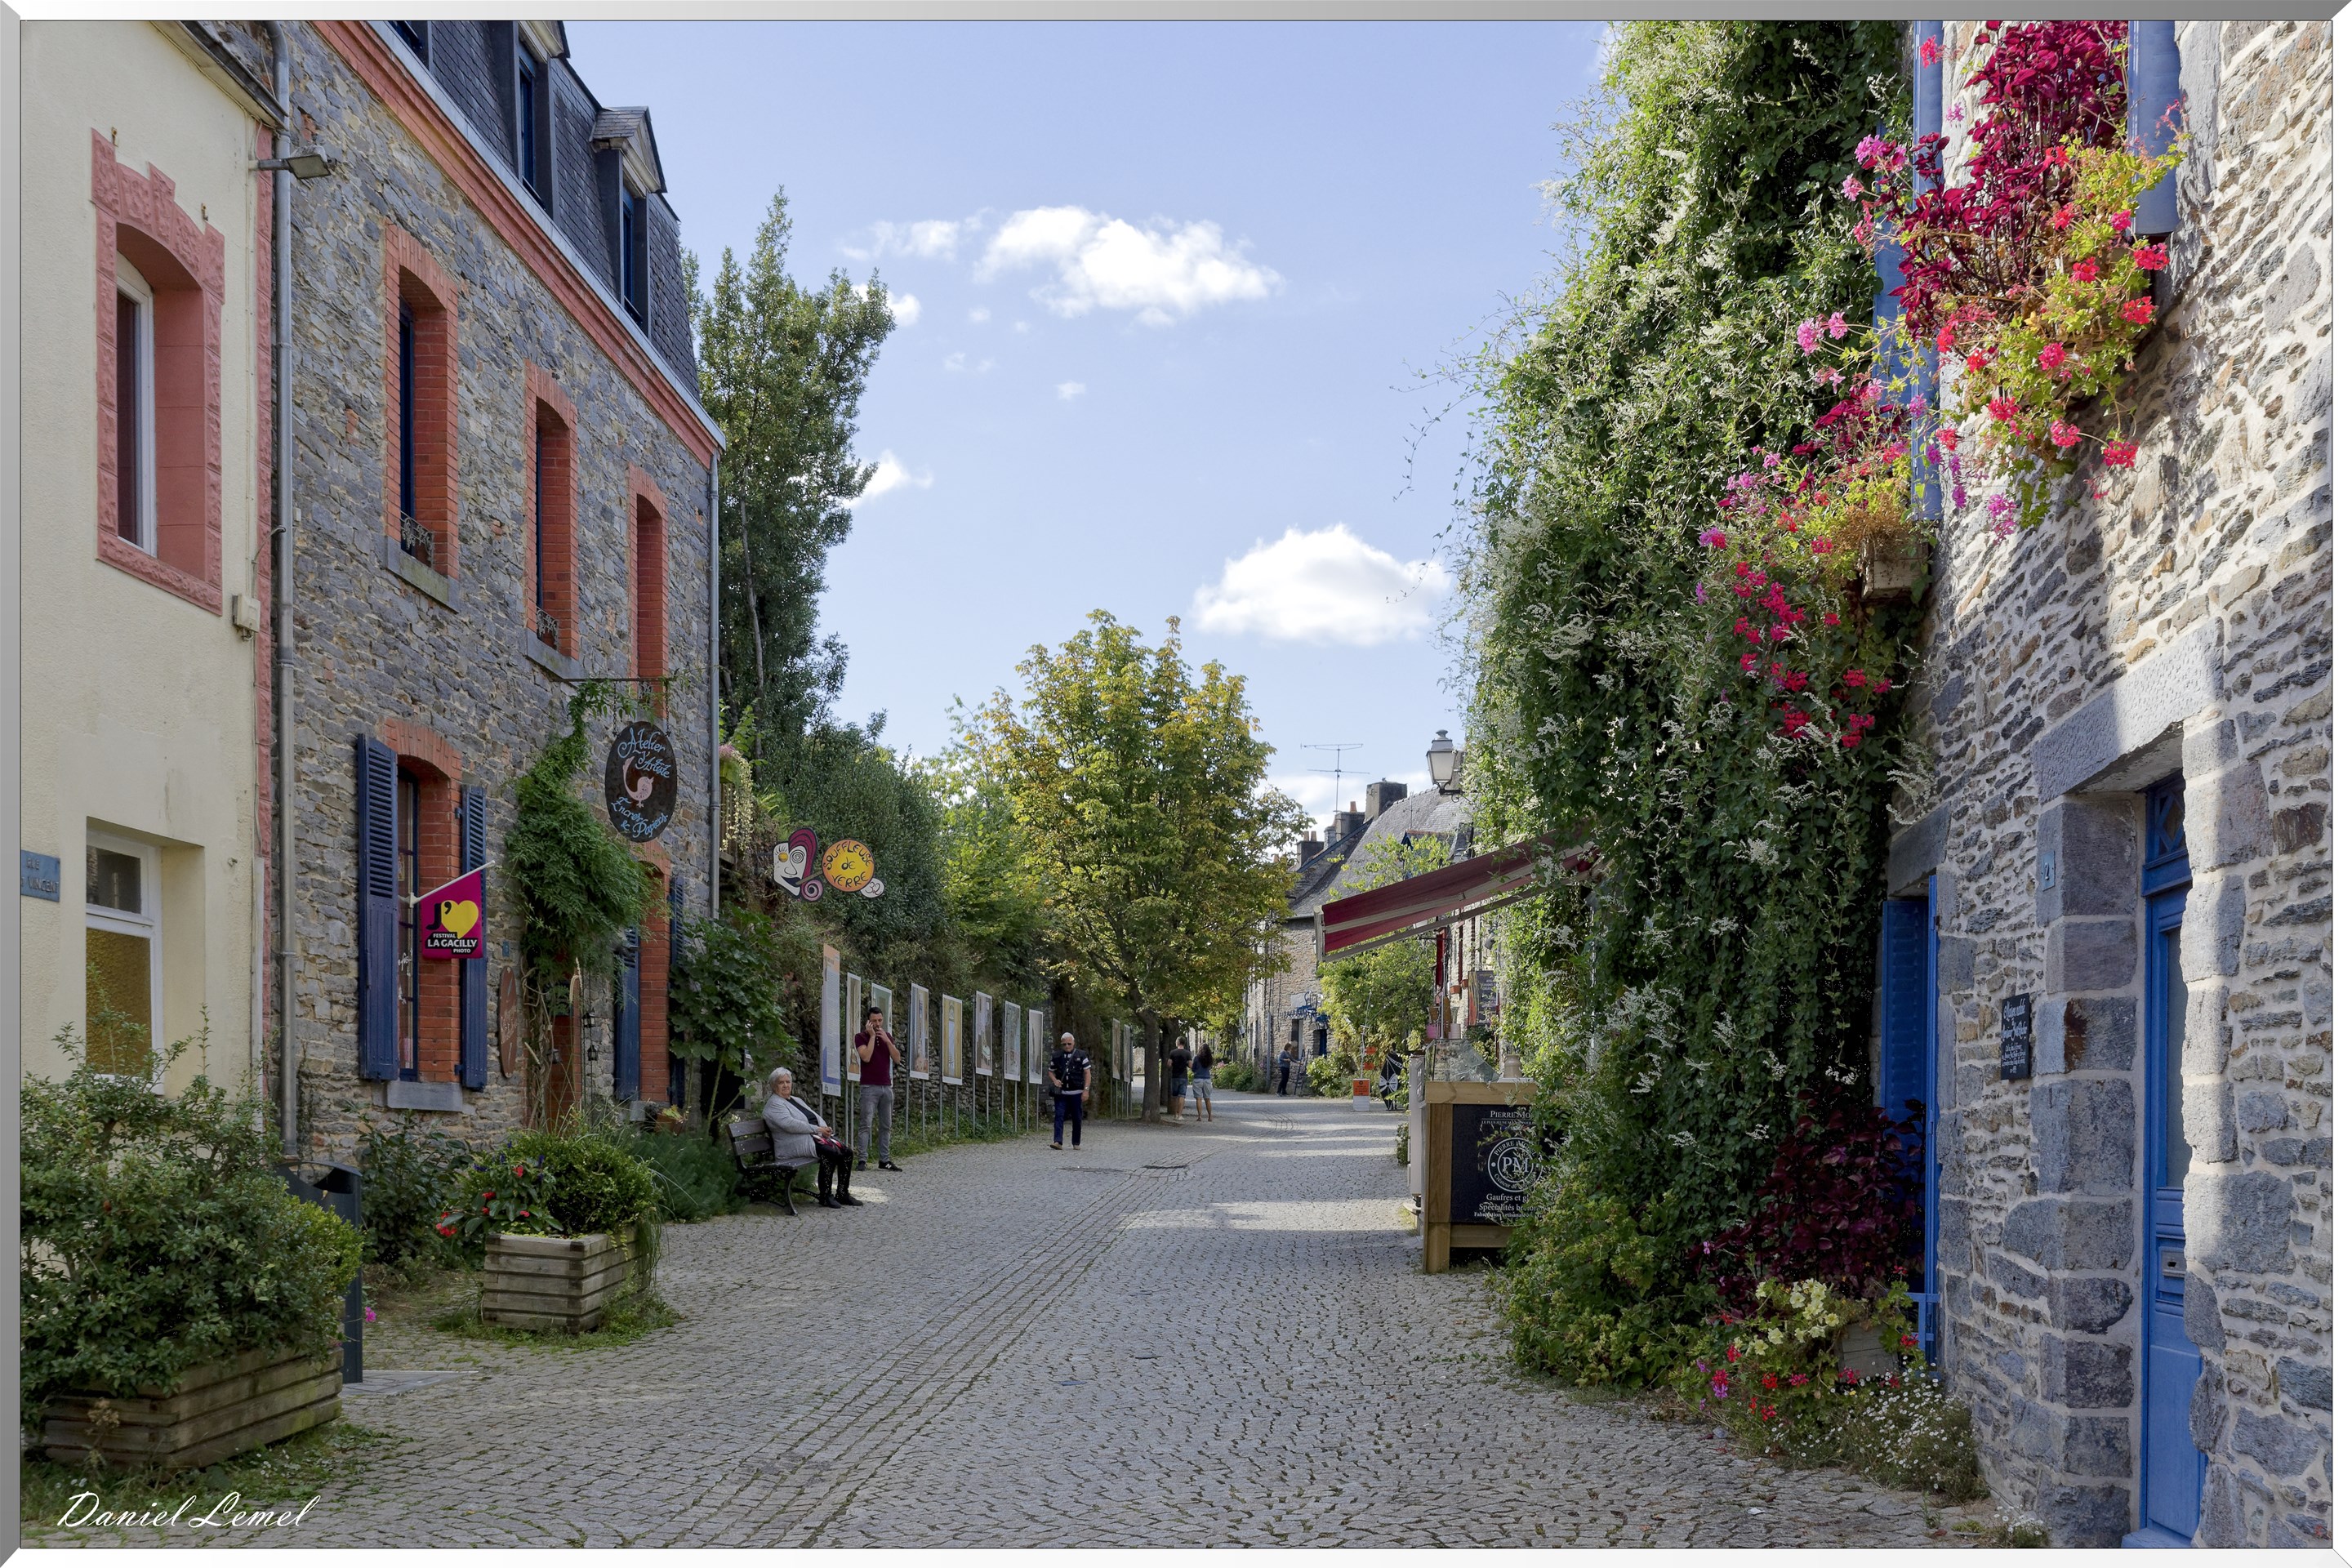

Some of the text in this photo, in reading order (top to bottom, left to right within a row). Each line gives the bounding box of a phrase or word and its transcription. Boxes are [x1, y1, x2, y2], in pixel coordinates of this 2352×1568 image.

[618, 728, 665, 758] Atelier
[611, 797, 644, 822] Encres
[633, 813, 668, 838] Papiers
[823, 841, 874, 870] SOUFFLEUSE
[28, 875, 59, 893] VINCENT
[831, 871, 868, 887] VERRE
[427, 939, 478, 947] LA GACILLY
[1490, 1110, 1516, 1118] PIERRE
[1494, 1140, 1515, 1156] PIERRE
